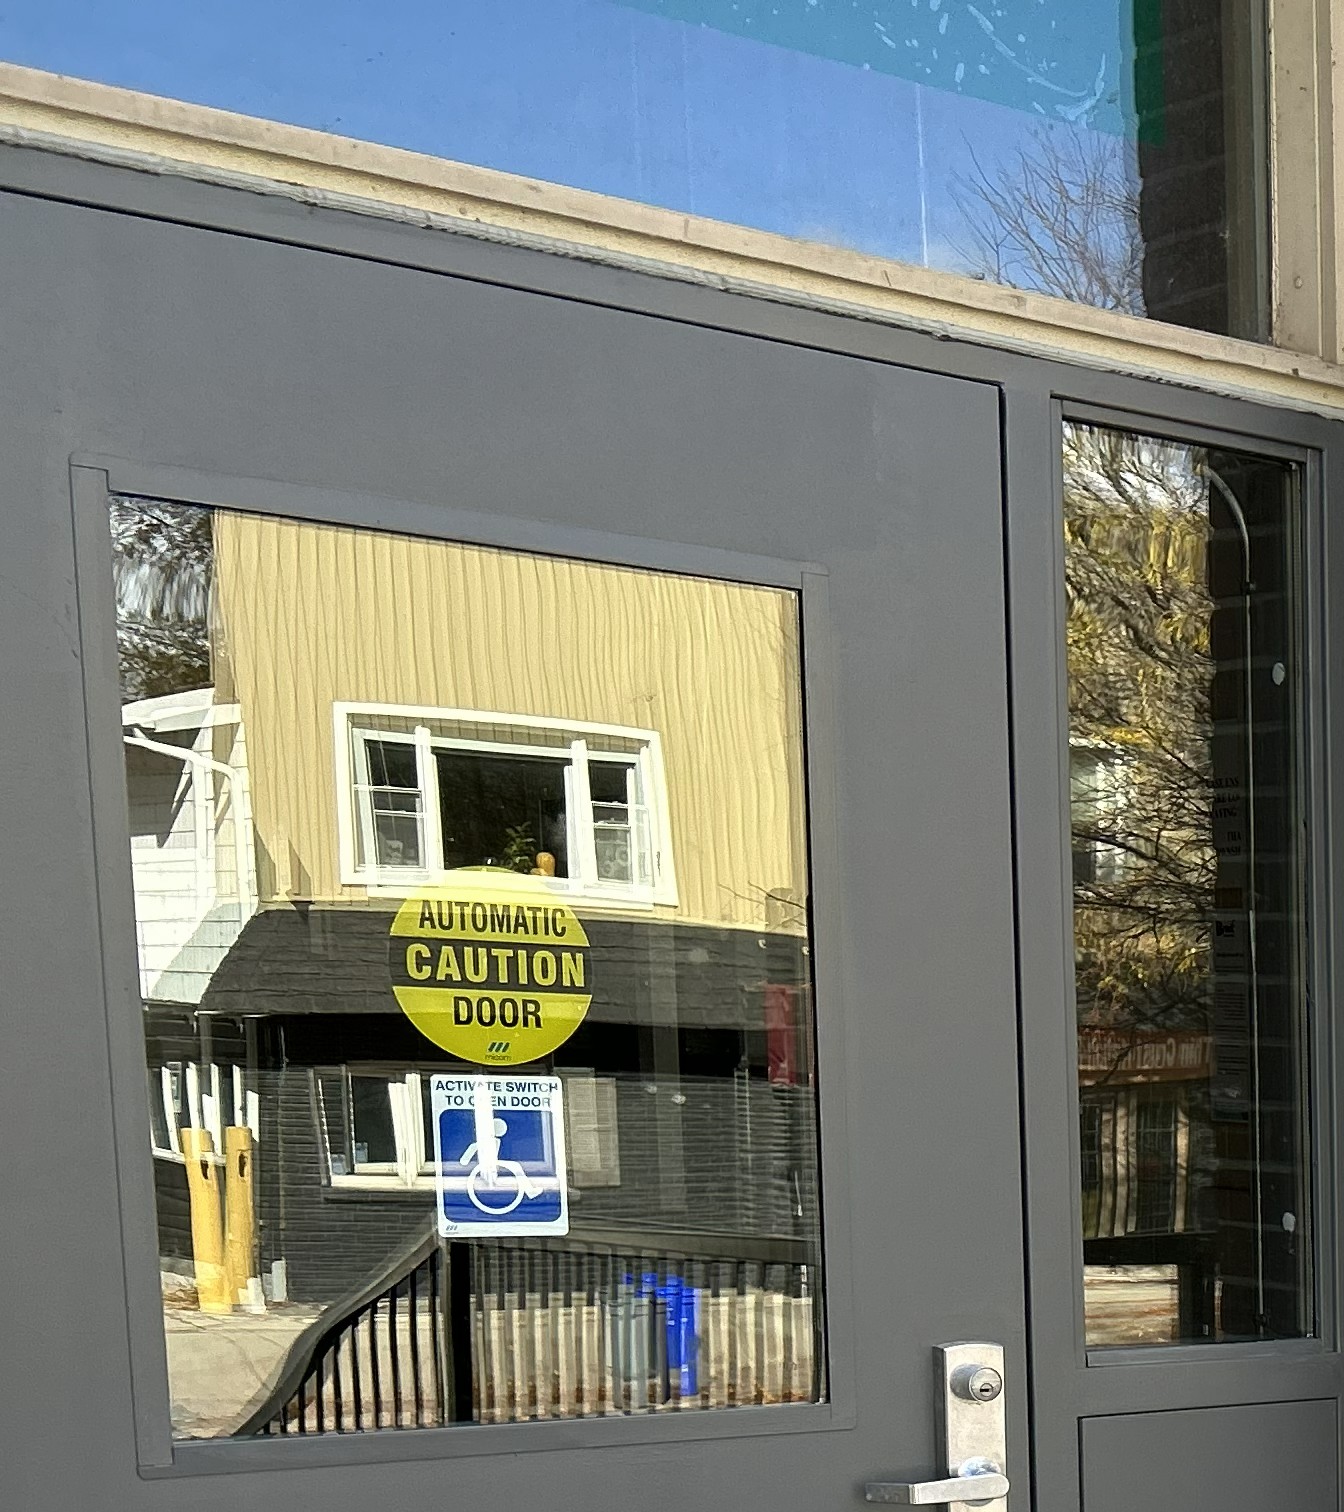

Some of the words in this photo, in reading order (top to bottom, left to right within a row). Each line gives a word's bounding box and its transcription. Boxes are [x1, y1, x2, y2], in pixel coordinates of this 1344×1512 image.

[419, 900, 567, 938] AUTOMATIC
[406, 943, 584, 988] CAUTION
[453, 996, 542, 1029] DOOR
[435, 1080, 502, 1092] ACTIVTE
[505, 1082, 558, 1093] SWITCH
[445, 1095, 464, 1106] TO
[511, 1096, 551, 1108] DOOR
